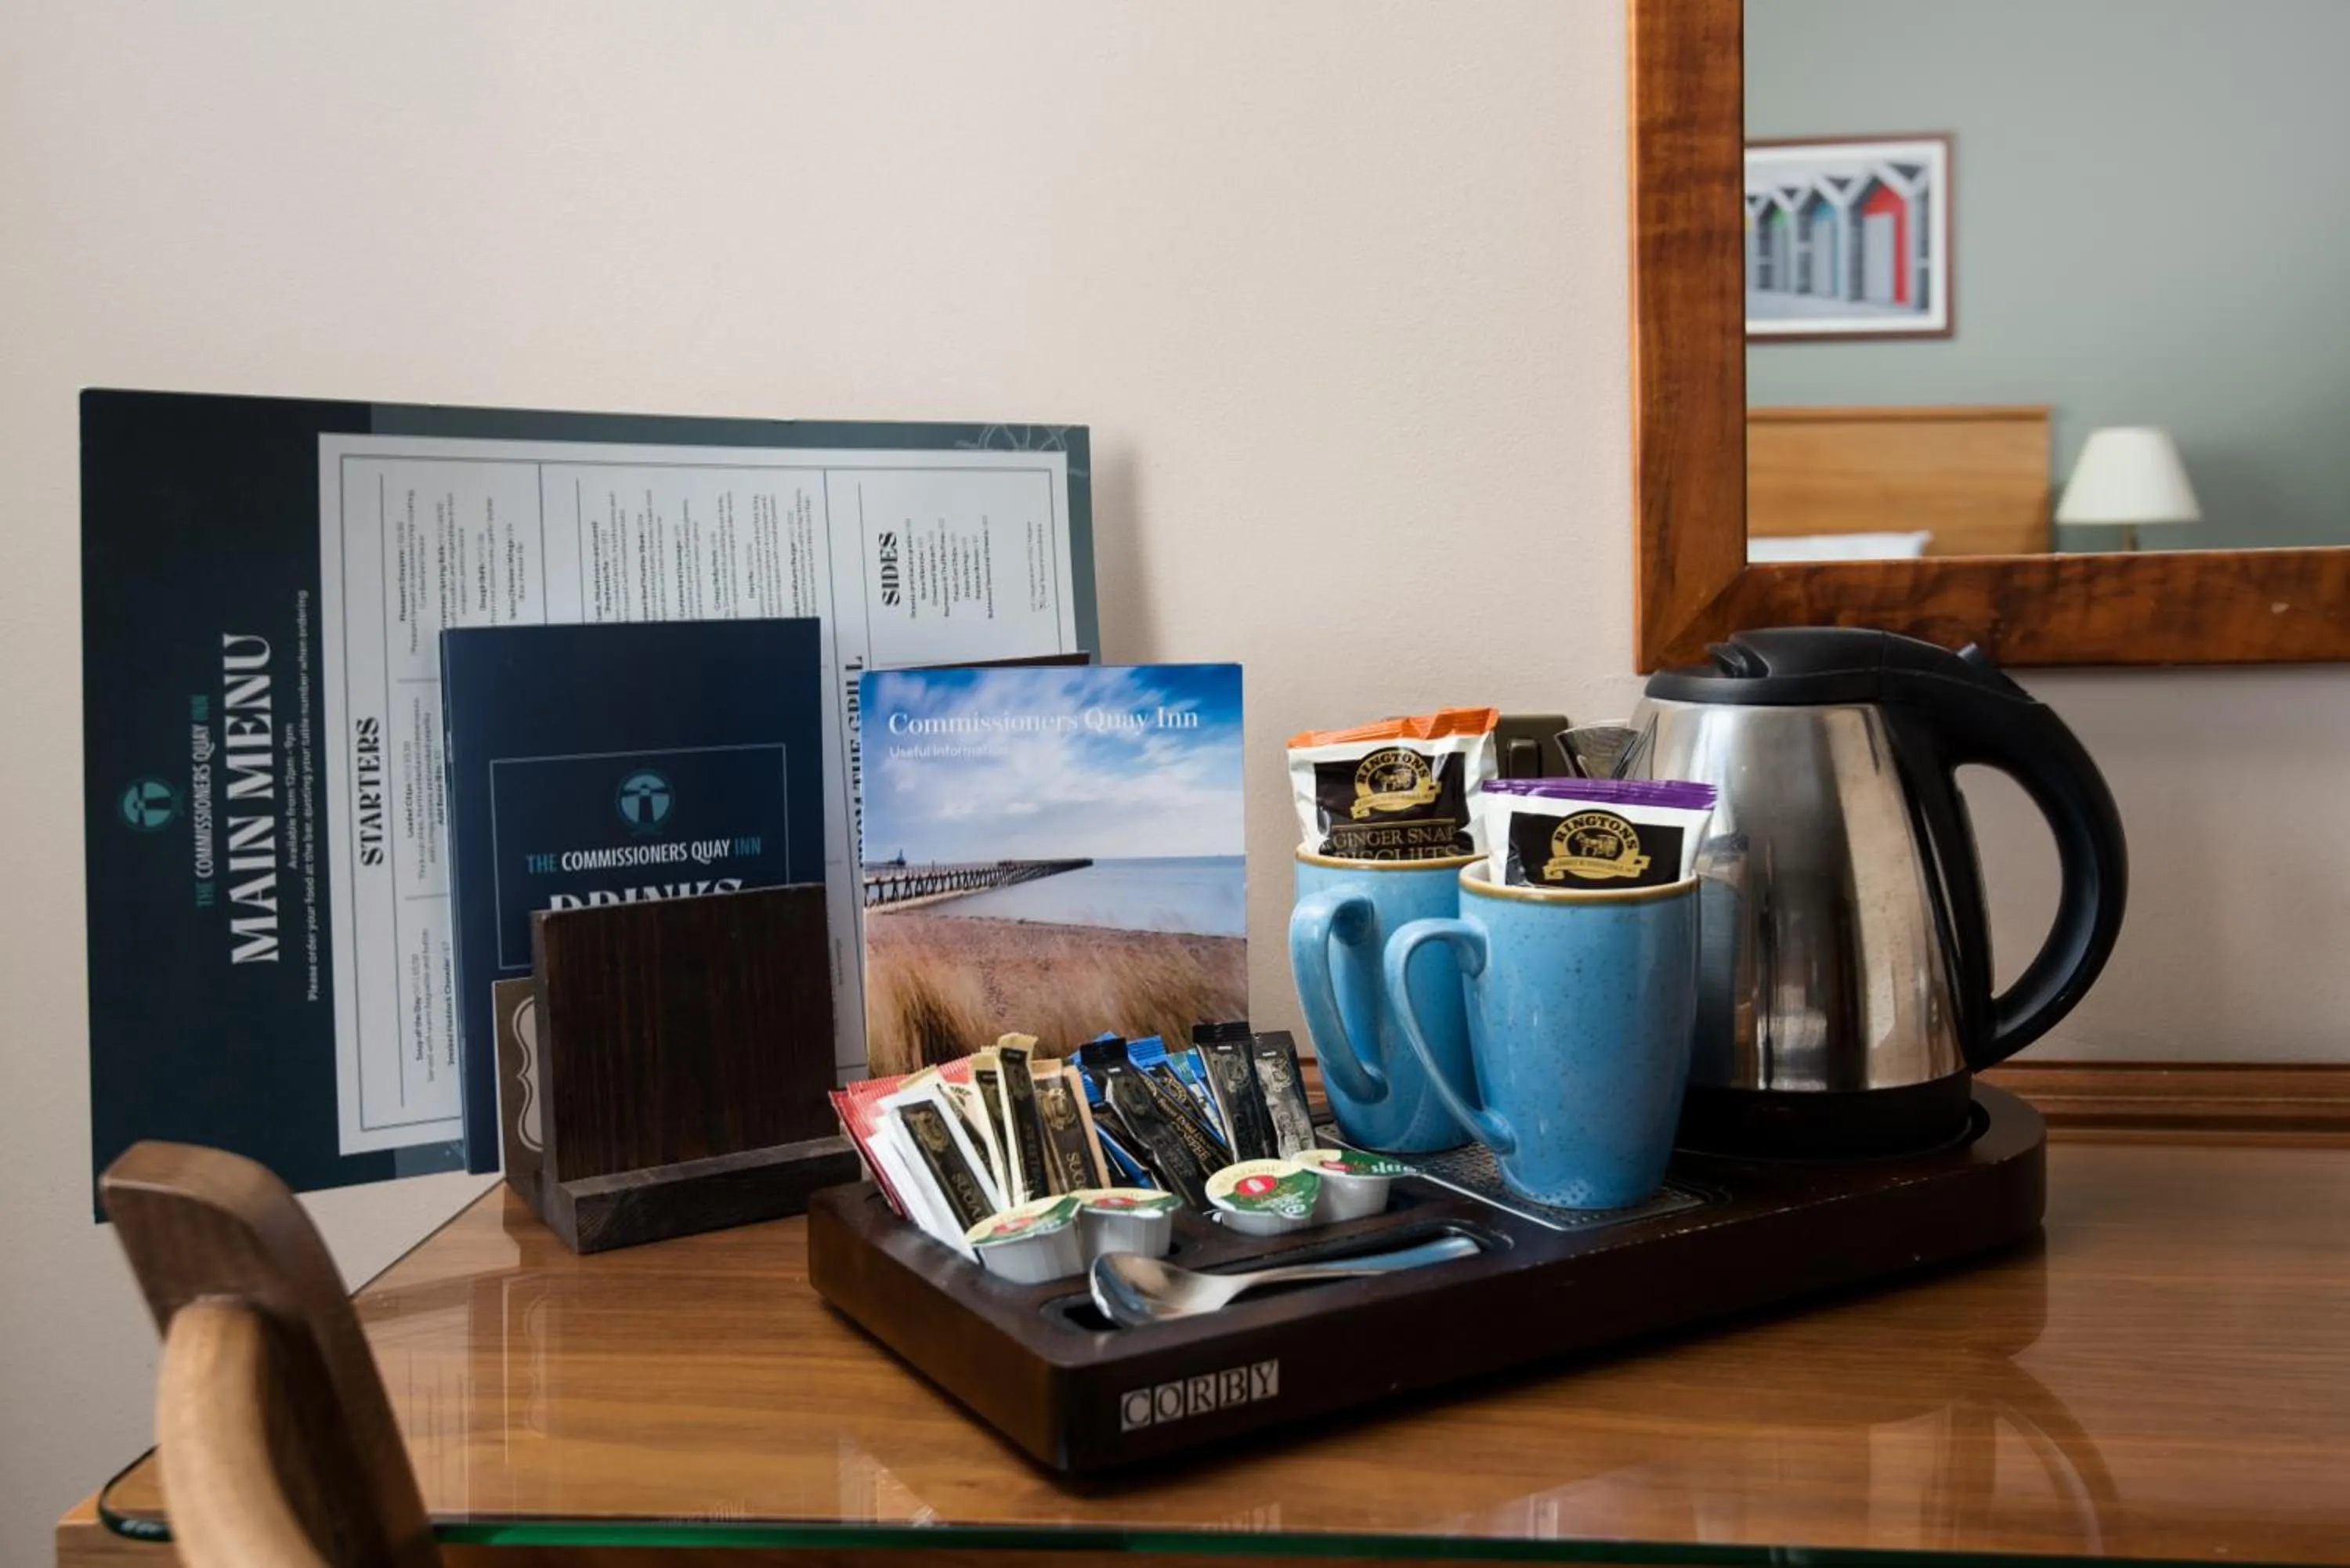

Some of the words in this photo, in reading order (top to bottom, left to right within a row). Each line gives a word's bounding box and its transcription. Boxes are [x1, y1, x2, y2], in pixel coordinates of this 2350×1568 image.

[878, 530, 901, 606] SIDES
[222, 631, 274, 799] MENU
[888, 710, 1078, 735] Commissioners
[1084, 706, 1148, 735] Quay
[1155, 706, 1198, 728] Inn
[191, 723, 215, 761] QUAY
[888, 745, 931, 758] Useful
[1357, 751, 1430, 784] RINGTONS
[285, 788, 296, 816] from
[356, 716, 384, 865] STARTERS
[193, 764, 213, 877] COMMISSIONERS
[1332, 828, 1405, 849] GINGER
[1553, 815, 1637, 850] RINGTONS
[287, 818, 298, 869] Available
[526, 853, 557, 874] THE
[561, 842, 687, 872] COMMISSIONERS
[692, 839, 731, 865] QUAY
[734, 836, 761, 856] INN
[228, 815, 280, 963] MAIN
[304, 876, 315, 902] food
[306, 906, 318, 930] your
[307, 963, 318, 1000] Please
[1123, 1360, 1277, 1427] CORBY
